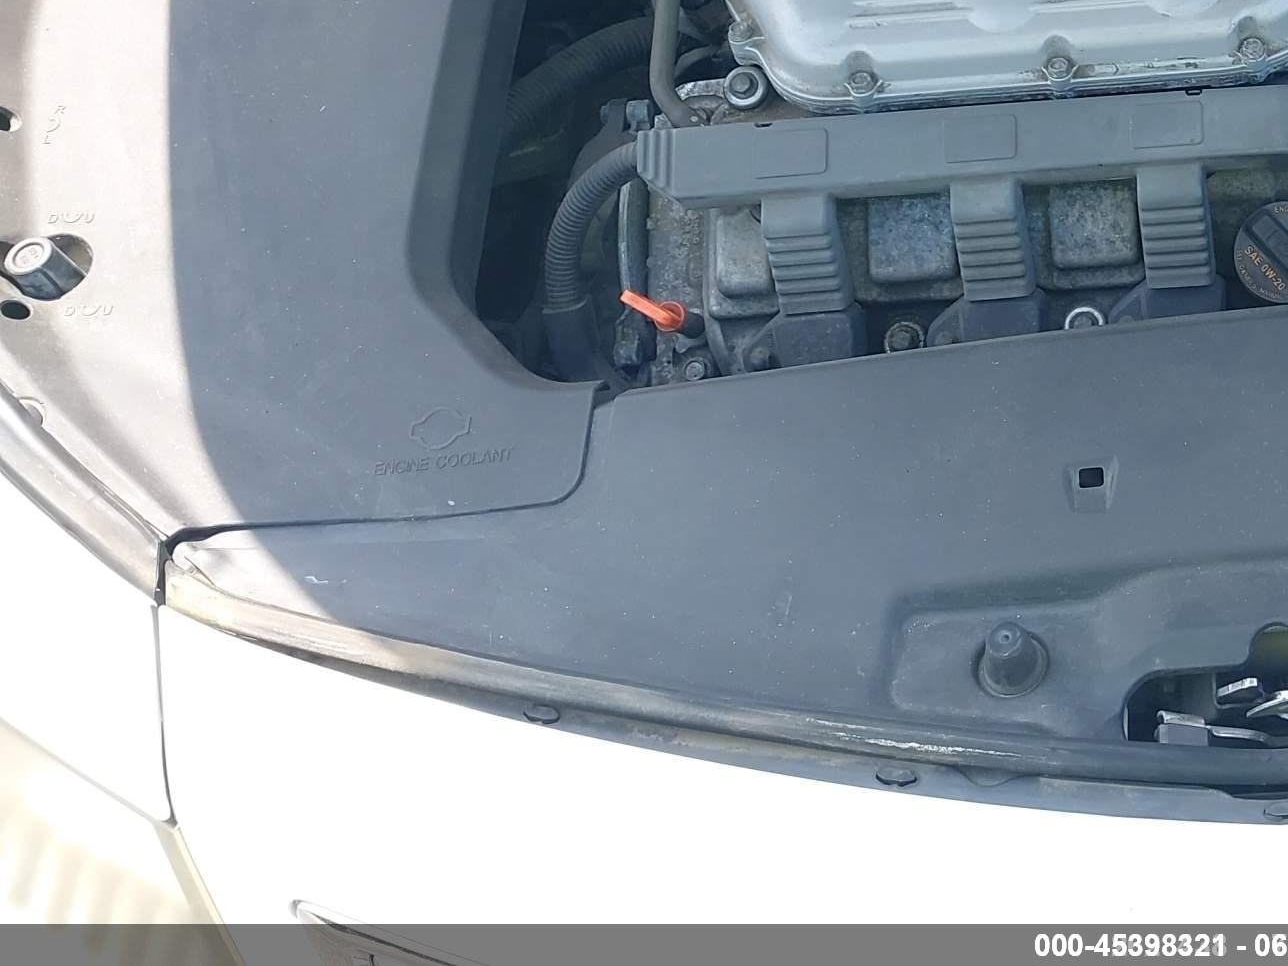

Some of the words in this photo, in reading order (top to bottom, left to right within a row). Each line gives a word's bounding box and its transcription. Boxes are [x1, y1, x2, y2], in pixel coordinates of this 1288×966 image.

[1244, 245, 1263, 266] SAE
[1261, 264, 1286, 291] 0W-20
[374, 457, 431, 476] ENGINE
[436, 447, 514, 470] COOLANT
